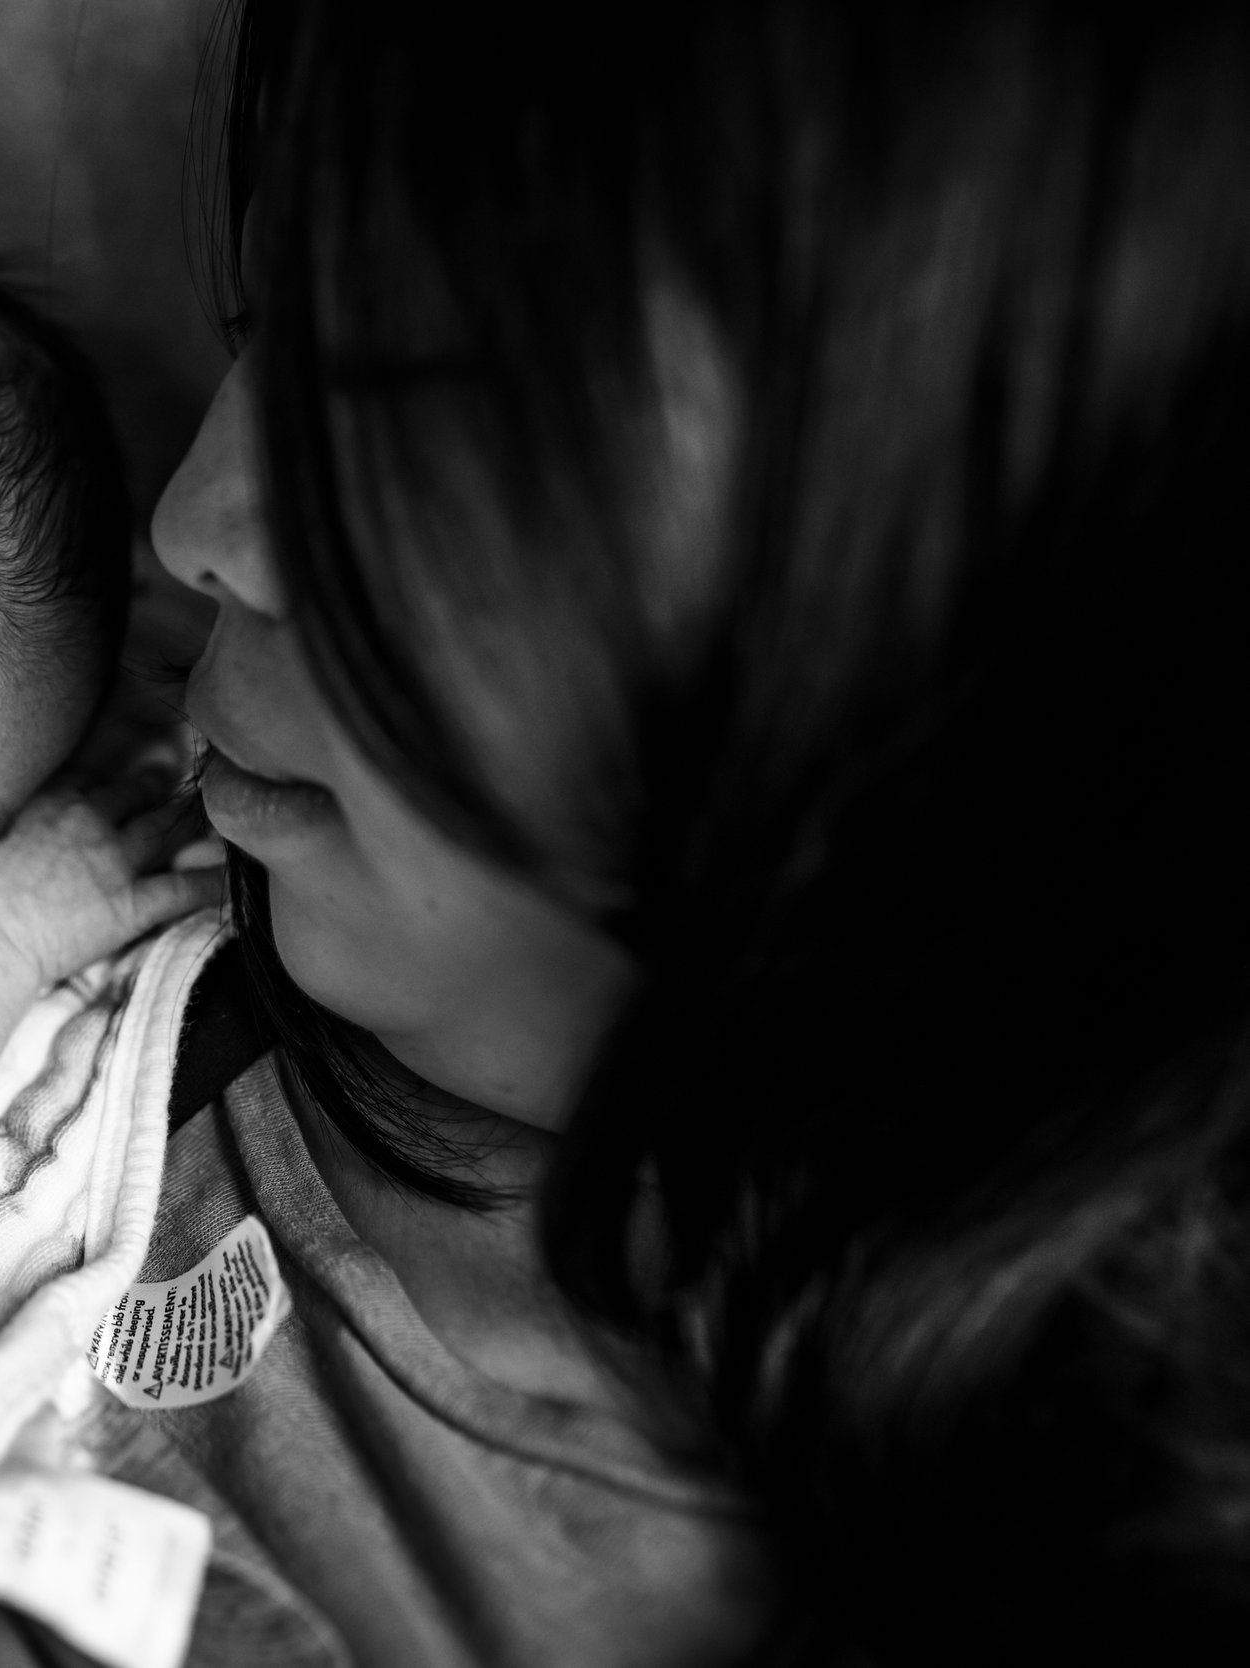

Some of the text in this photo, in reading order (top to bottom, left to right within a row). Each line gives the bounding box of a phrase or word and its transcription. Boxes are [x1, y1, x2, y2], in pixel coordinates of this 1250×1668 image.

[111, 1312, 124, 1327] bib
[187, 1285, 197, 1327] l'enfant
[107, 1327, 121, 1359] remove
[114, 1299, 145, 1384] child while sleeping
[132, 1306, 156, 1382] or unsupervised.
[152, 1286, 177, 1381] AVERTISSEMENT:
[166, 1296, 187, 1386] Veuillez retirer le
[185, 1327, 195, 1342] de
[193, 1344, 205, 1391] pendant
